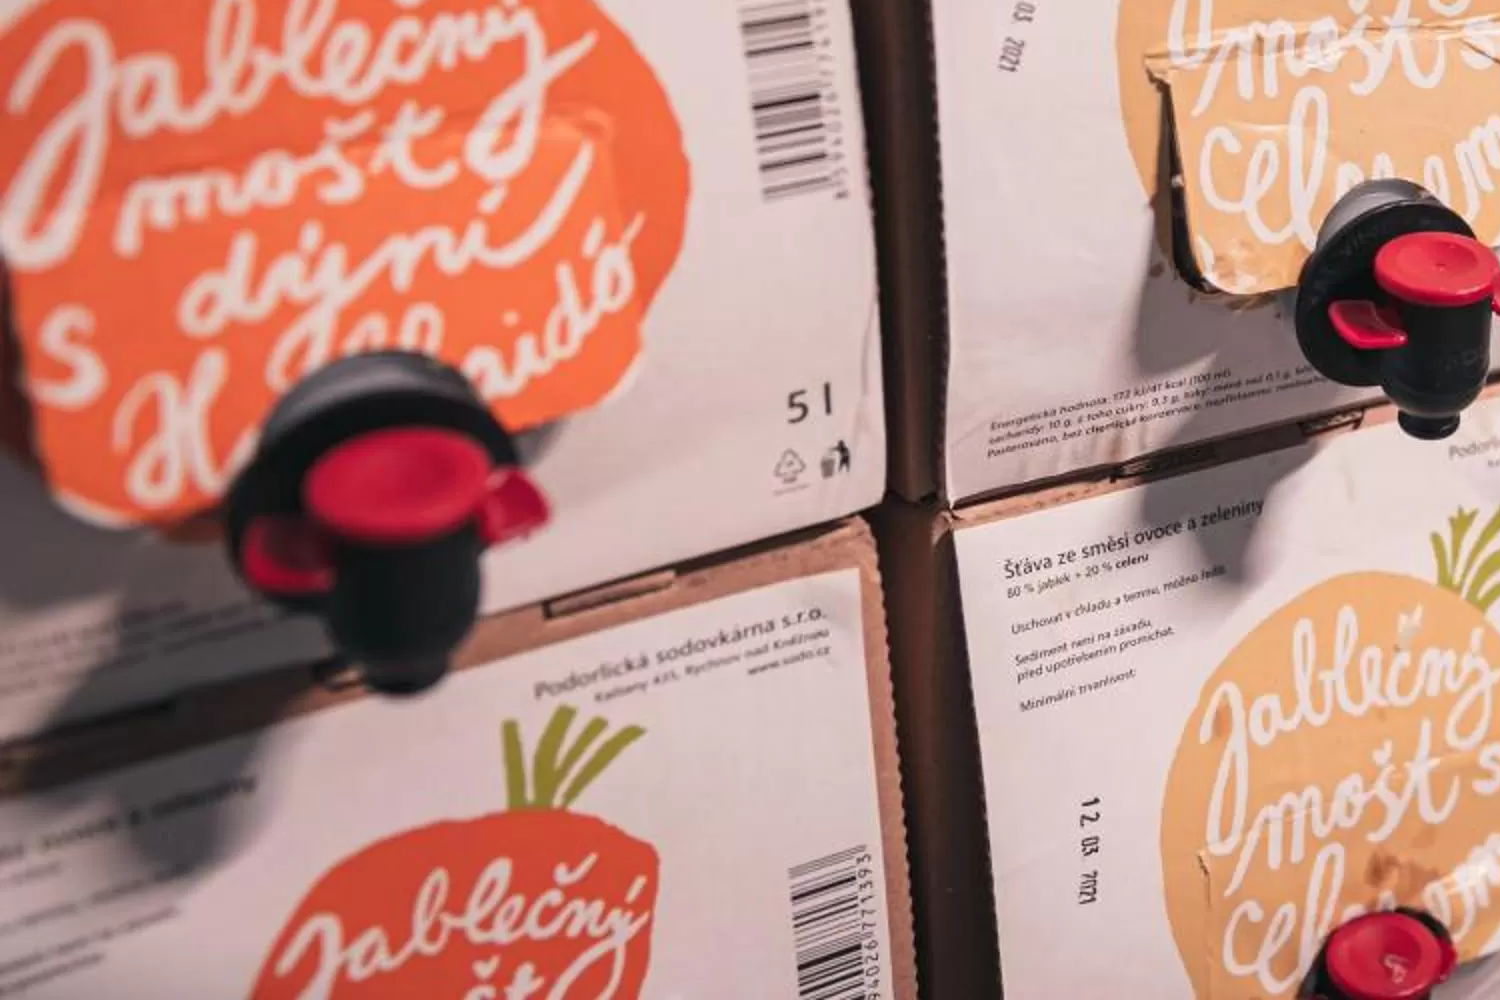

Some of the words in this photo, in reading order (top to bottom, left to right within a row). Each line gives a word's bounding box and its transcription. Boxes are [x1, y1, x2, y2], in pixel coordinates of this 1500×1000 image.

[113, 106, 459, 258] mošt
[32, 304, 108, 409] s
[112, 212, 646, 507] Haidó
[787, 388, 808, 424] 5
[1002, 550, 1054, 581] Šťáva
[1058, 547, 1078, 567] ze
[1081, 530, 1130, 560] směsi
[1134, 521, 1183, 547] ovoce
[1186, 516, 1197, 532] a
[1200, 498, 1265, 529] zeleniny
[1115, 552, 1151, 571] celeru
[533, 653, 650, 701] Podorlická
[655, 617, 776, 665] sodovkárna
[781, 606, 828, 629] s.r.o.
[1079, 796, 1100, 828] 12
[1224, 719, 1461, 898] mošt
[273, 851, 652, 1000] Jablečný
